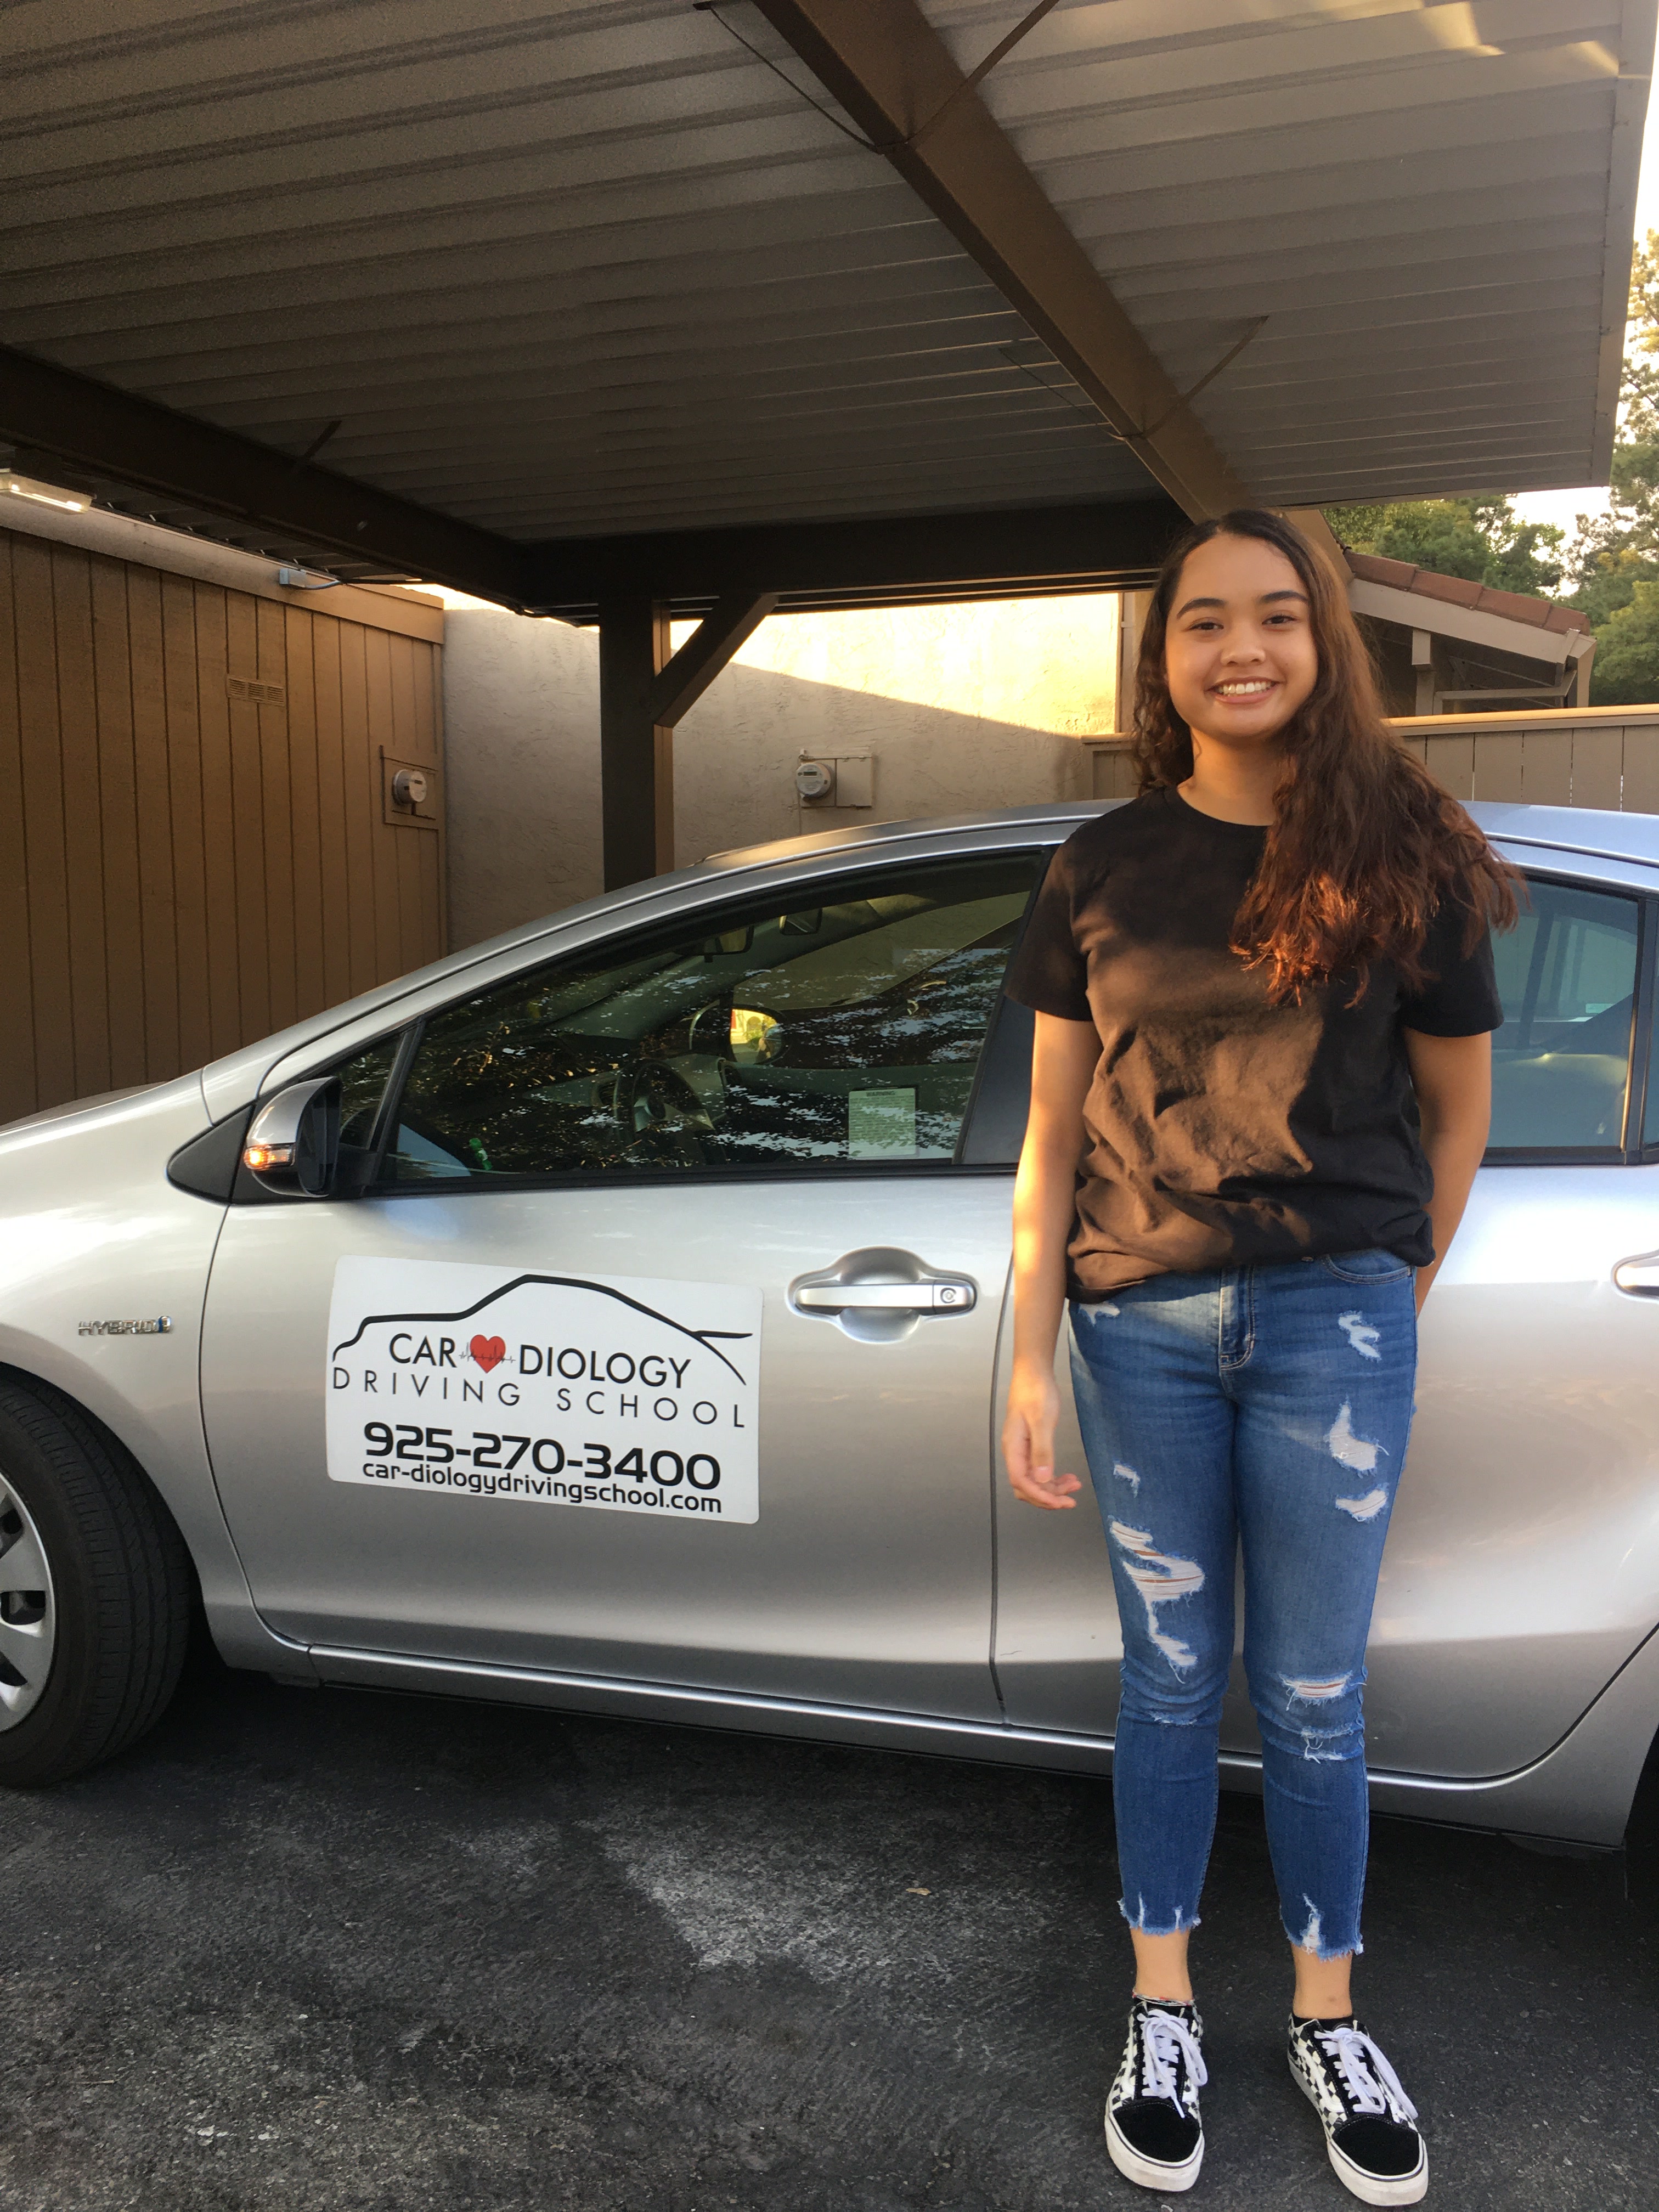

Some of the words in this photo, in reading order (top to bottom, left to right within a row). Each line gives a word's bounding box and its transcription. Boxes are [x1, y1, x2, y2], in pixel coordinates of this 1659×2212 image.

[78, 1320, 158, 1335] HYBRID
[389, 1333, 456, 1368] CAR
[520, 1344, 691, 1389] DIOLOGY
[333, 1367, 520, 1406] DRIVING
[557, 1388, 744, 1428] SCHOOL
[364, 1421, 721, 1490] 925-270-3400
[363, 1463, 721, 1513] car-diologydrivingschool.com
